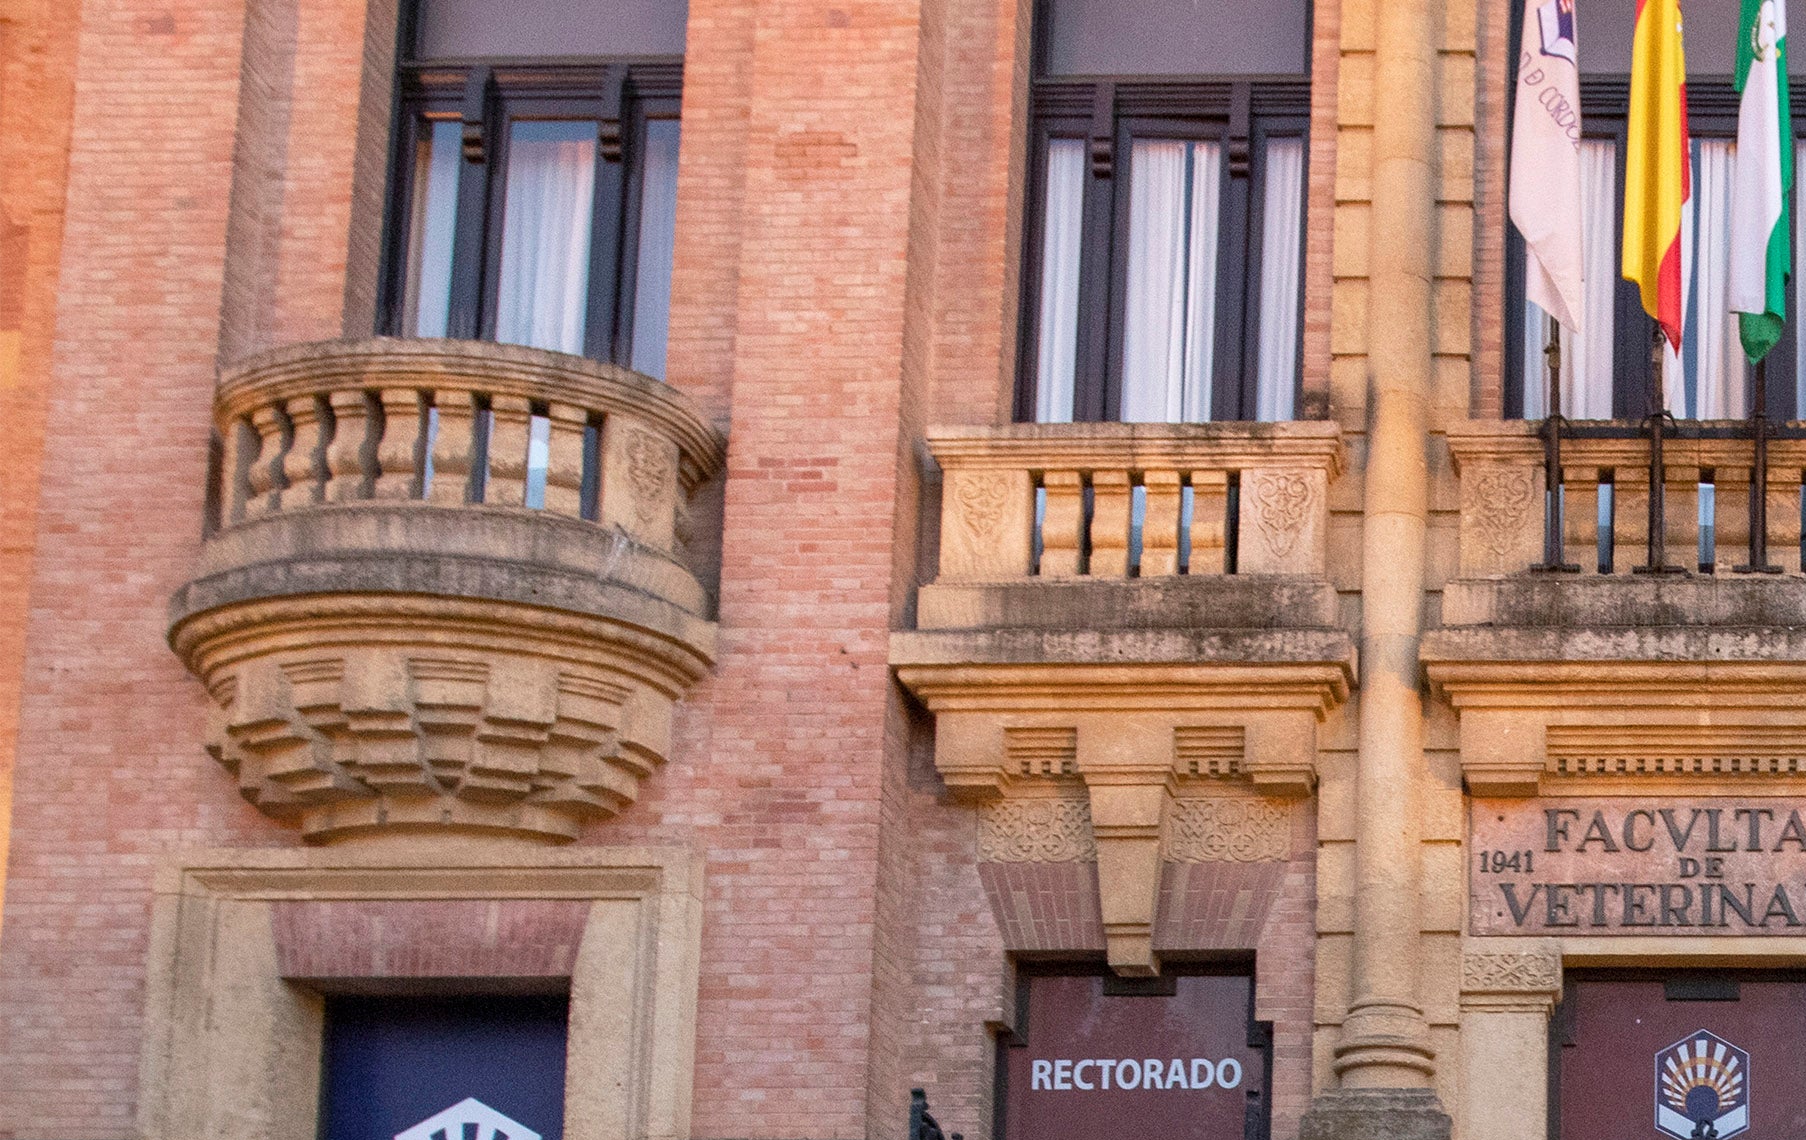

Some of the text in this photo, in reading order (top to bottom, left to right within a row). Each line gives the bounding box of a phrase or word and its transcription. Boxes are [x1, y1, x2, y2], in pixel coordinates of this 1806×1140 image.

[1479, 850, 1535, 873] 1941
[1678, 857, 1724, 879] DE
[1030, 1057, 1243, 1091] RECTORADO
